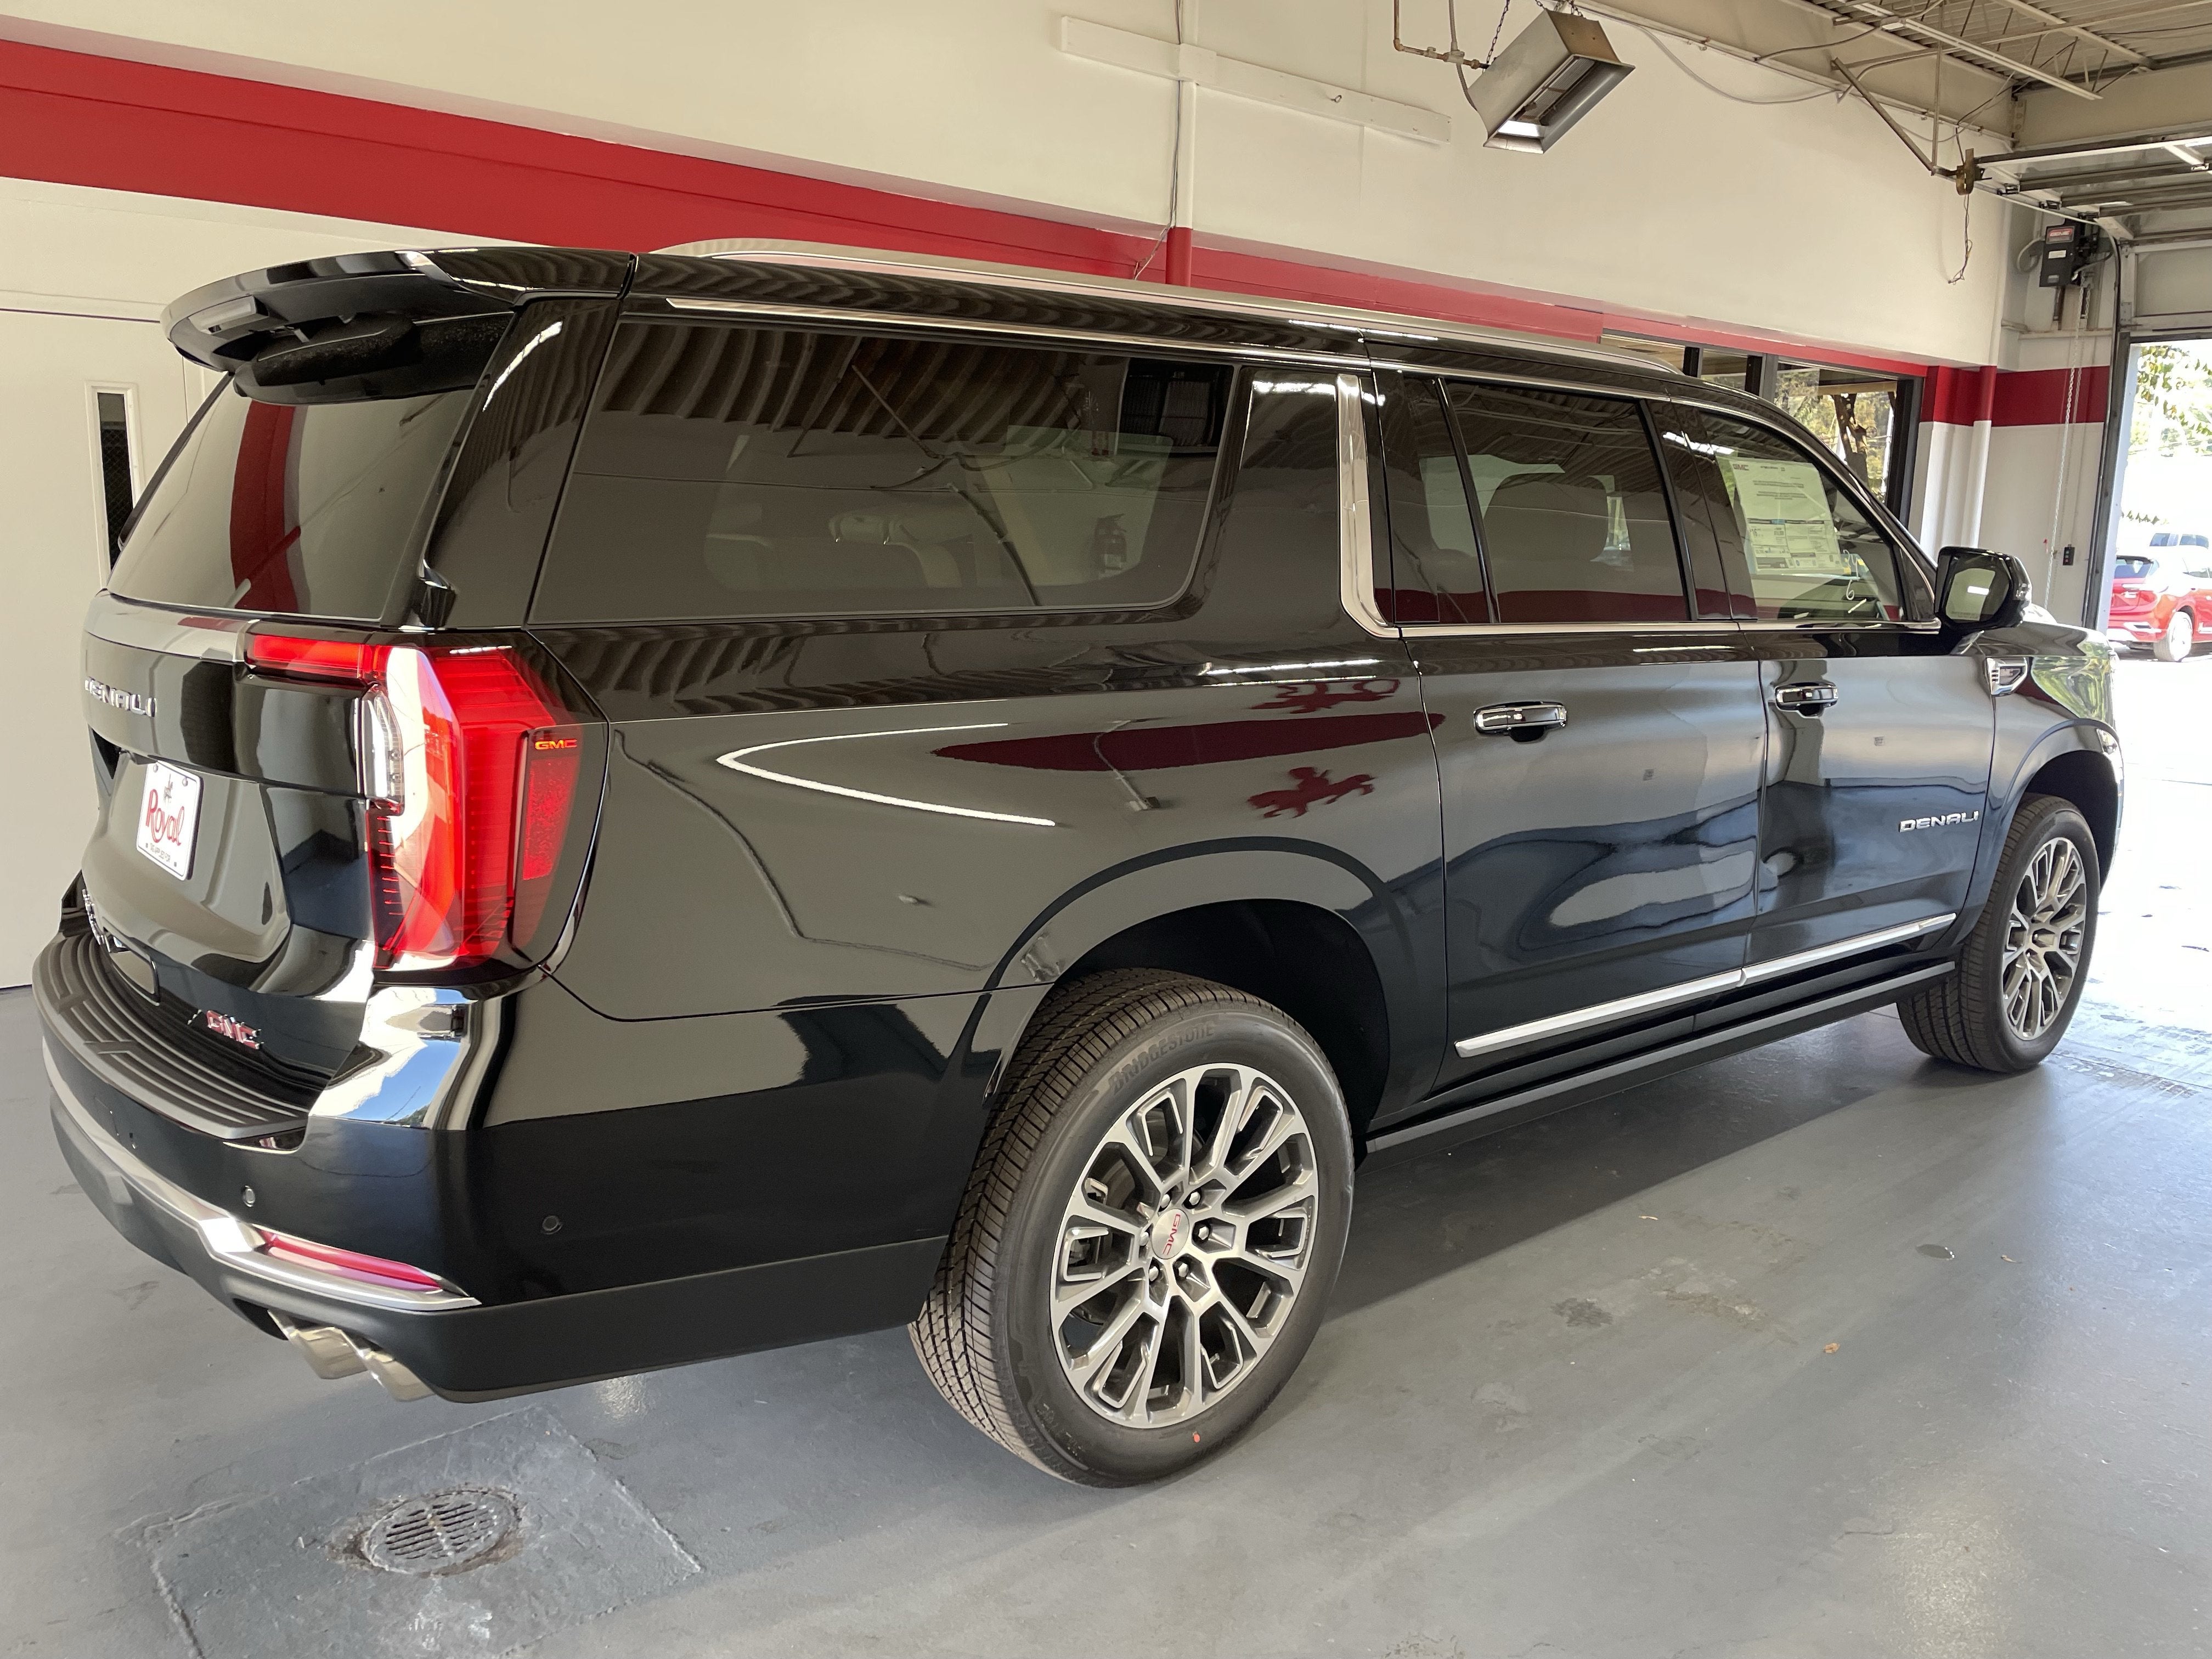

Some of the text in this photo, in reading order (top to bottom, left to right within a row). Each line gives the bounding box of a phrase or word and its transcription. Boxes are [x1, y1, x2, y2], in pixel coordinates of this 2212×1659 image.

[534, 739, 577, 750] GMC
[145, 789, 184, 846] Royal
[1899, 810, 1979, 833] DENALI
[206, 1010, 262, 1049] GMC
[1162, 1214, 1181, 1256] GMC
